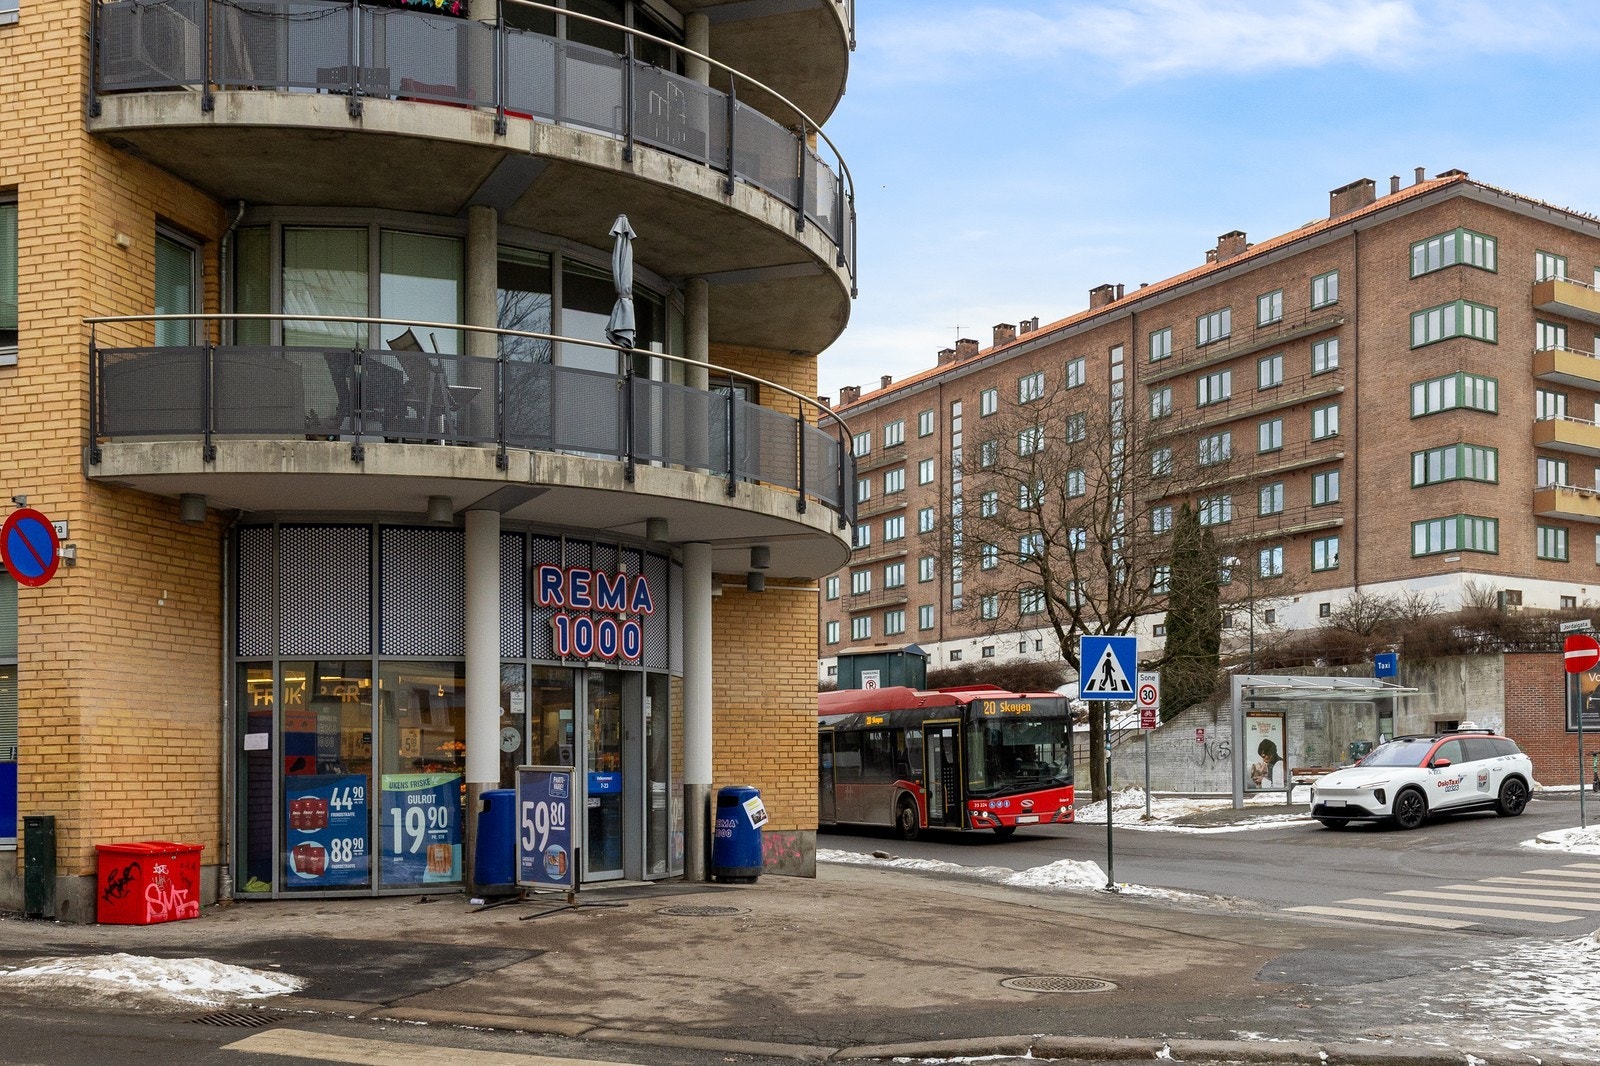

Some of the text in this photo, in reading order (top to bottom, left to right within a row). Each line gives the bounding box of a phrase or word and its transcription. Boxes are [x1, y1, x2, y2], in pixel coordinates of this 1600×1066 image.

[534, 561, 655, 615] REMA
[551, 612, 643, 660] 1000
[1377, 661, 1391, 670] Taxi
[1140, 673, 1156, 681] Sone
[1142, 689, 1154, 700] 30
[983, 701, 1031, 715] 20 Skøyen
[389, 778, 431, 790] UKENS FRISKE
[330, 786, 364, 811] 44 90
[407, 794, 437, 804] GULROT
[390, 806, 448, 854] 19 90
[522, 801, 565, 852] 59 80
[716, 818, 736, 828] EMA
[331, 837, 364, 863] 88 90
